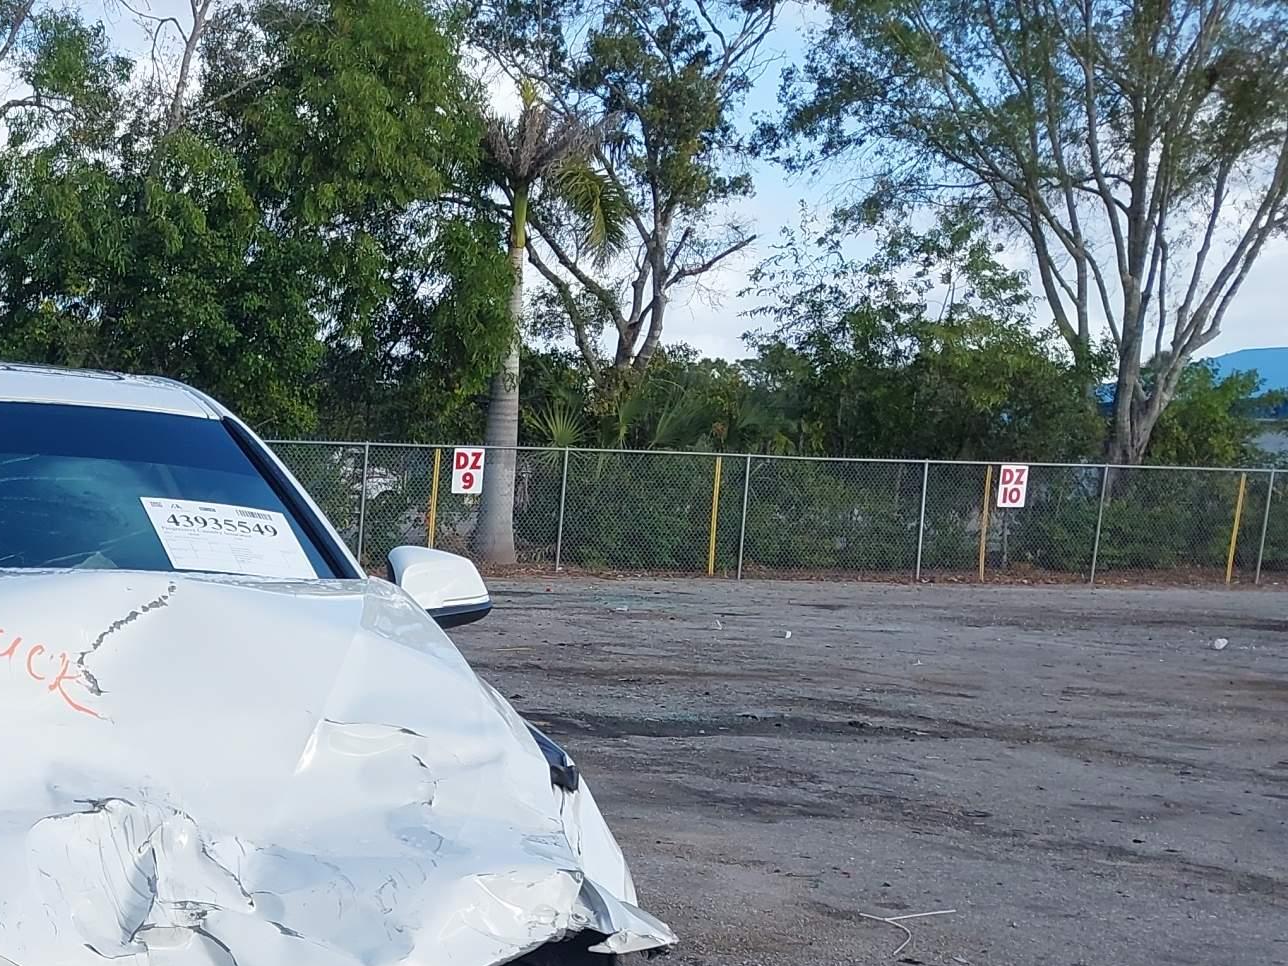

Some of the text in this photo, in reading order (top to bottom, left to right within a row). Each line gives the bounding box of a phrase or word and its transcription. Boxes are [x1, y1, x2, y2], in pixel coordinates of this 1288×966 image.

[455, 451, 483, 470] DZ
[462, 472, 474, 490] 9
[1002, 468, 1026, 485] DZ
[1002, 487, 1021, 504] 10
[167, 513, 278, 537] 43935549
